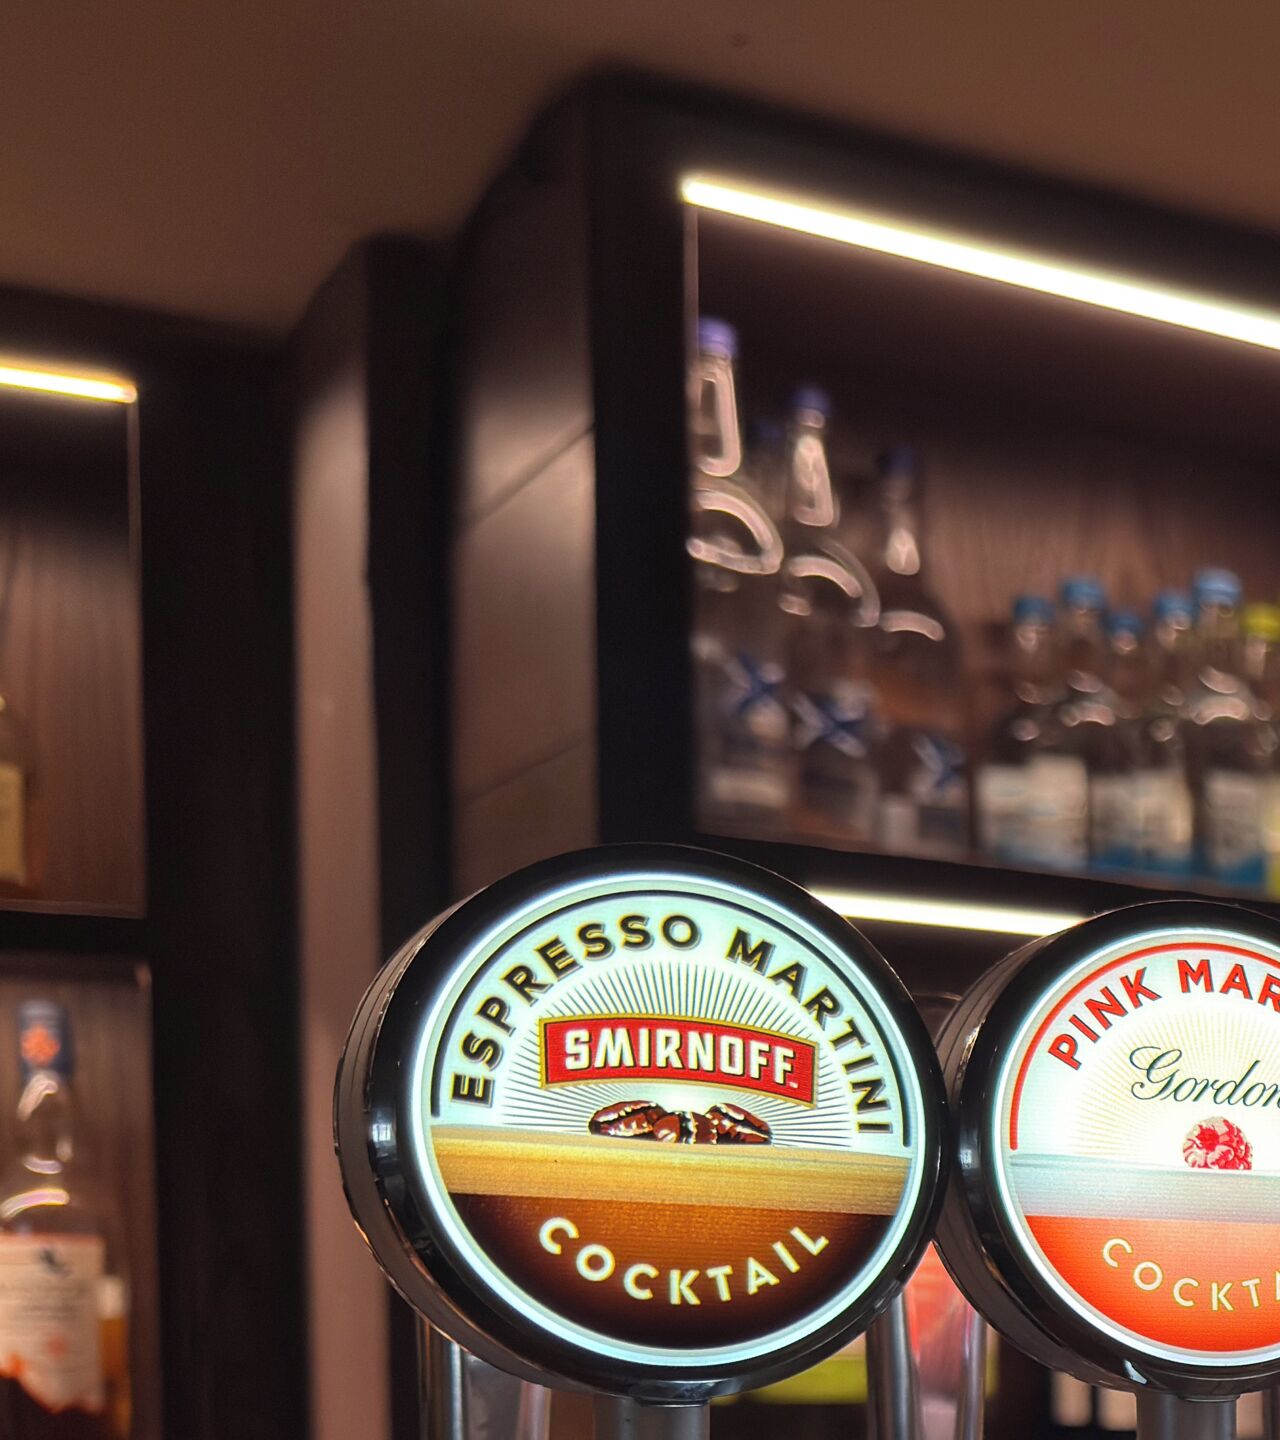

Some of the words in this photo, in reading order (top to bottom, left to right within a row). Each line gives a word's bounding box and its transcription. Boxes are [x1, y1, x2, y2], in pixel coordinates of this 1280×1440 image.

[450, 913, 700, 1108] ESPRESSO
[726, 926, 893, 1136] MARTINI
[563, 1026, 796, 1086] SMIRNOFF
[1047, 965, 1163, 1071] PINK
[537, 1215, 830, 1307] COCKTAIL
